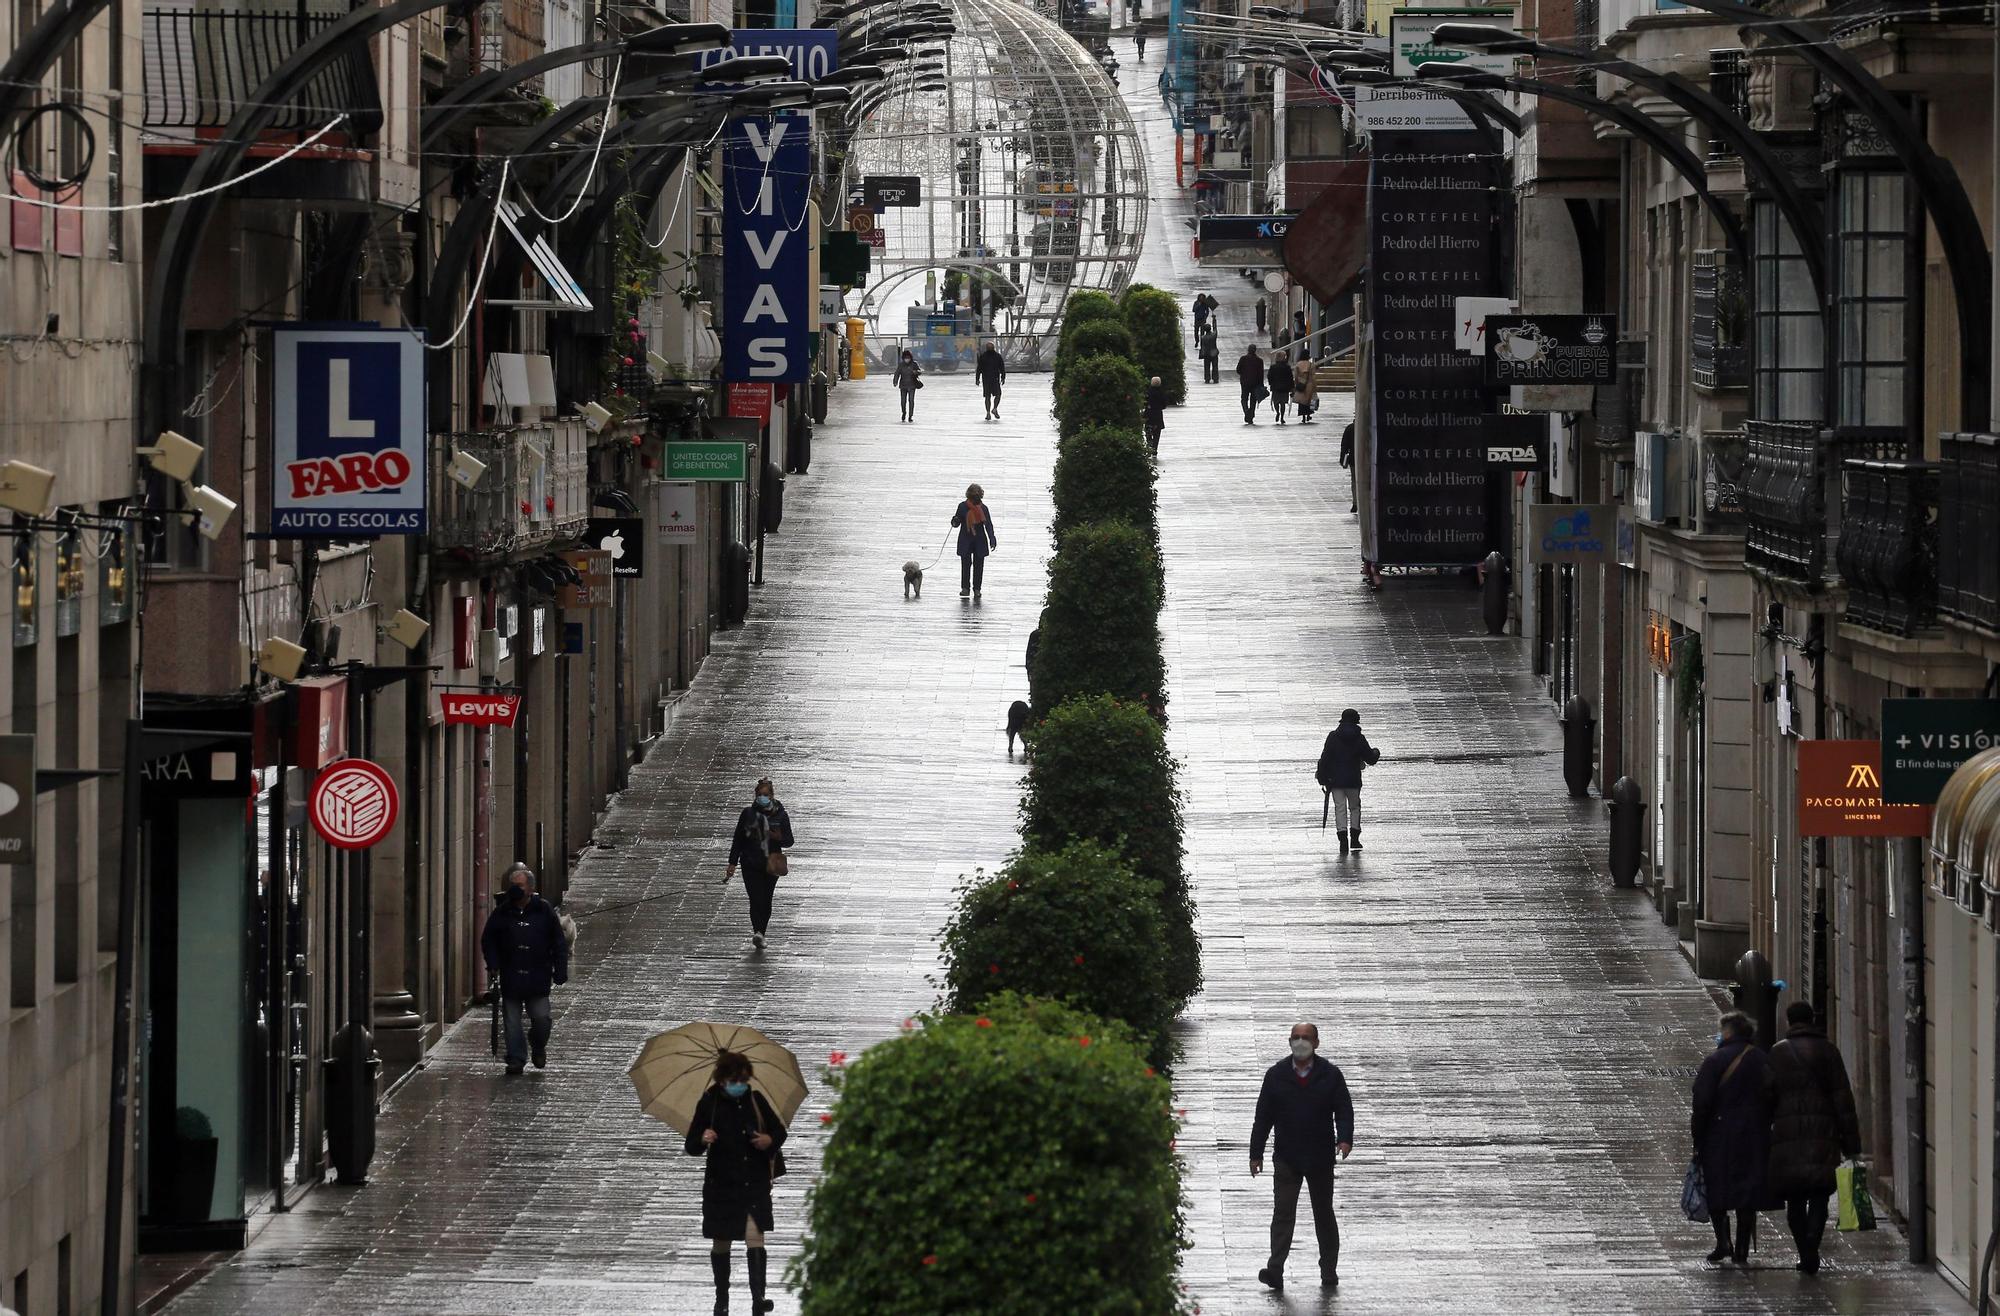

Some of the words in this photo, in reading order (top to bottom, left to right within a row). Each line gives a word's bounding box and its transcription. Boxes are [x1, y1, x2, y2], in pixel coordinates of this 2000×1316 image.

[1367, 117, 1384, 126] 986
[1386, 117, 1403, 126] 452
[1404, 117, 1421, 126] 200
[1382, 153, 1480, 163] CORTEFIEL
[1383, 176, 1418, 190] Pedro
[1420, 176, 1436, 190] del
[1440, 176, 1481, 190] Hierro
[1381, 213, 1480, 222] CORTEFIEL
[1382, 235, 1417, 249] Pedro
[1420, 235, 1436, 249] del
[1440, 235, 1480, 249] Hierro
[743, 123, 789, 377] VIVAS
[1382, 271, 1480, 281] CORTEFIEL
[1384, 294, 1418, 308] Pedro
[1421, 294, 1438, 308] del
[1382, 331, 1456, 340] CORTEF
[1556, 345, 1610, 358] PUERTA
[1384, 353, 1418, 367] Pedro
[1420, 353, 1437, 367] del
[1441, 353, 1480, 367] Hierro
[1496, 358, 1609, 379] PRINCIPE
[329, 358, 375, 438] L
[1384, 389, 1480, 399] CORTEFIEL
[1386, 412, 1419, 426] Pedro
[1421, 412, 1438, 426] del
[1442, 412, 1482, 426] Hierro
[672, 453, 702, 461] UNITED
[704, 453, 738, 461] COLORS
[1487, 444, 1538, 462] DADÁ
[672, 461, 684, 469] OF
[286, 451, 411, 499] FARO
[1388, 471, 1423, 486] Pedro
[1424, 471, 1441, 486] del
[1445, 471, 1485, 486] Hierro
[1386, 506, 1483, 516] CORTEFIEL
[279, 513, 332, 527] AUTO
[338, 512, 419, 528] ESCOLAS
[1388, 529, 1422, 543] Pedro
[1424, 529, 1441, 543] del
[1445, 529, 1485, 543] Hierro
[1895, 760, 1905, 769] El
[1908, 759, 1920, 769] fin
[1922, 759, 1936, 769] de
[1937, 759, 1952, 769] las
